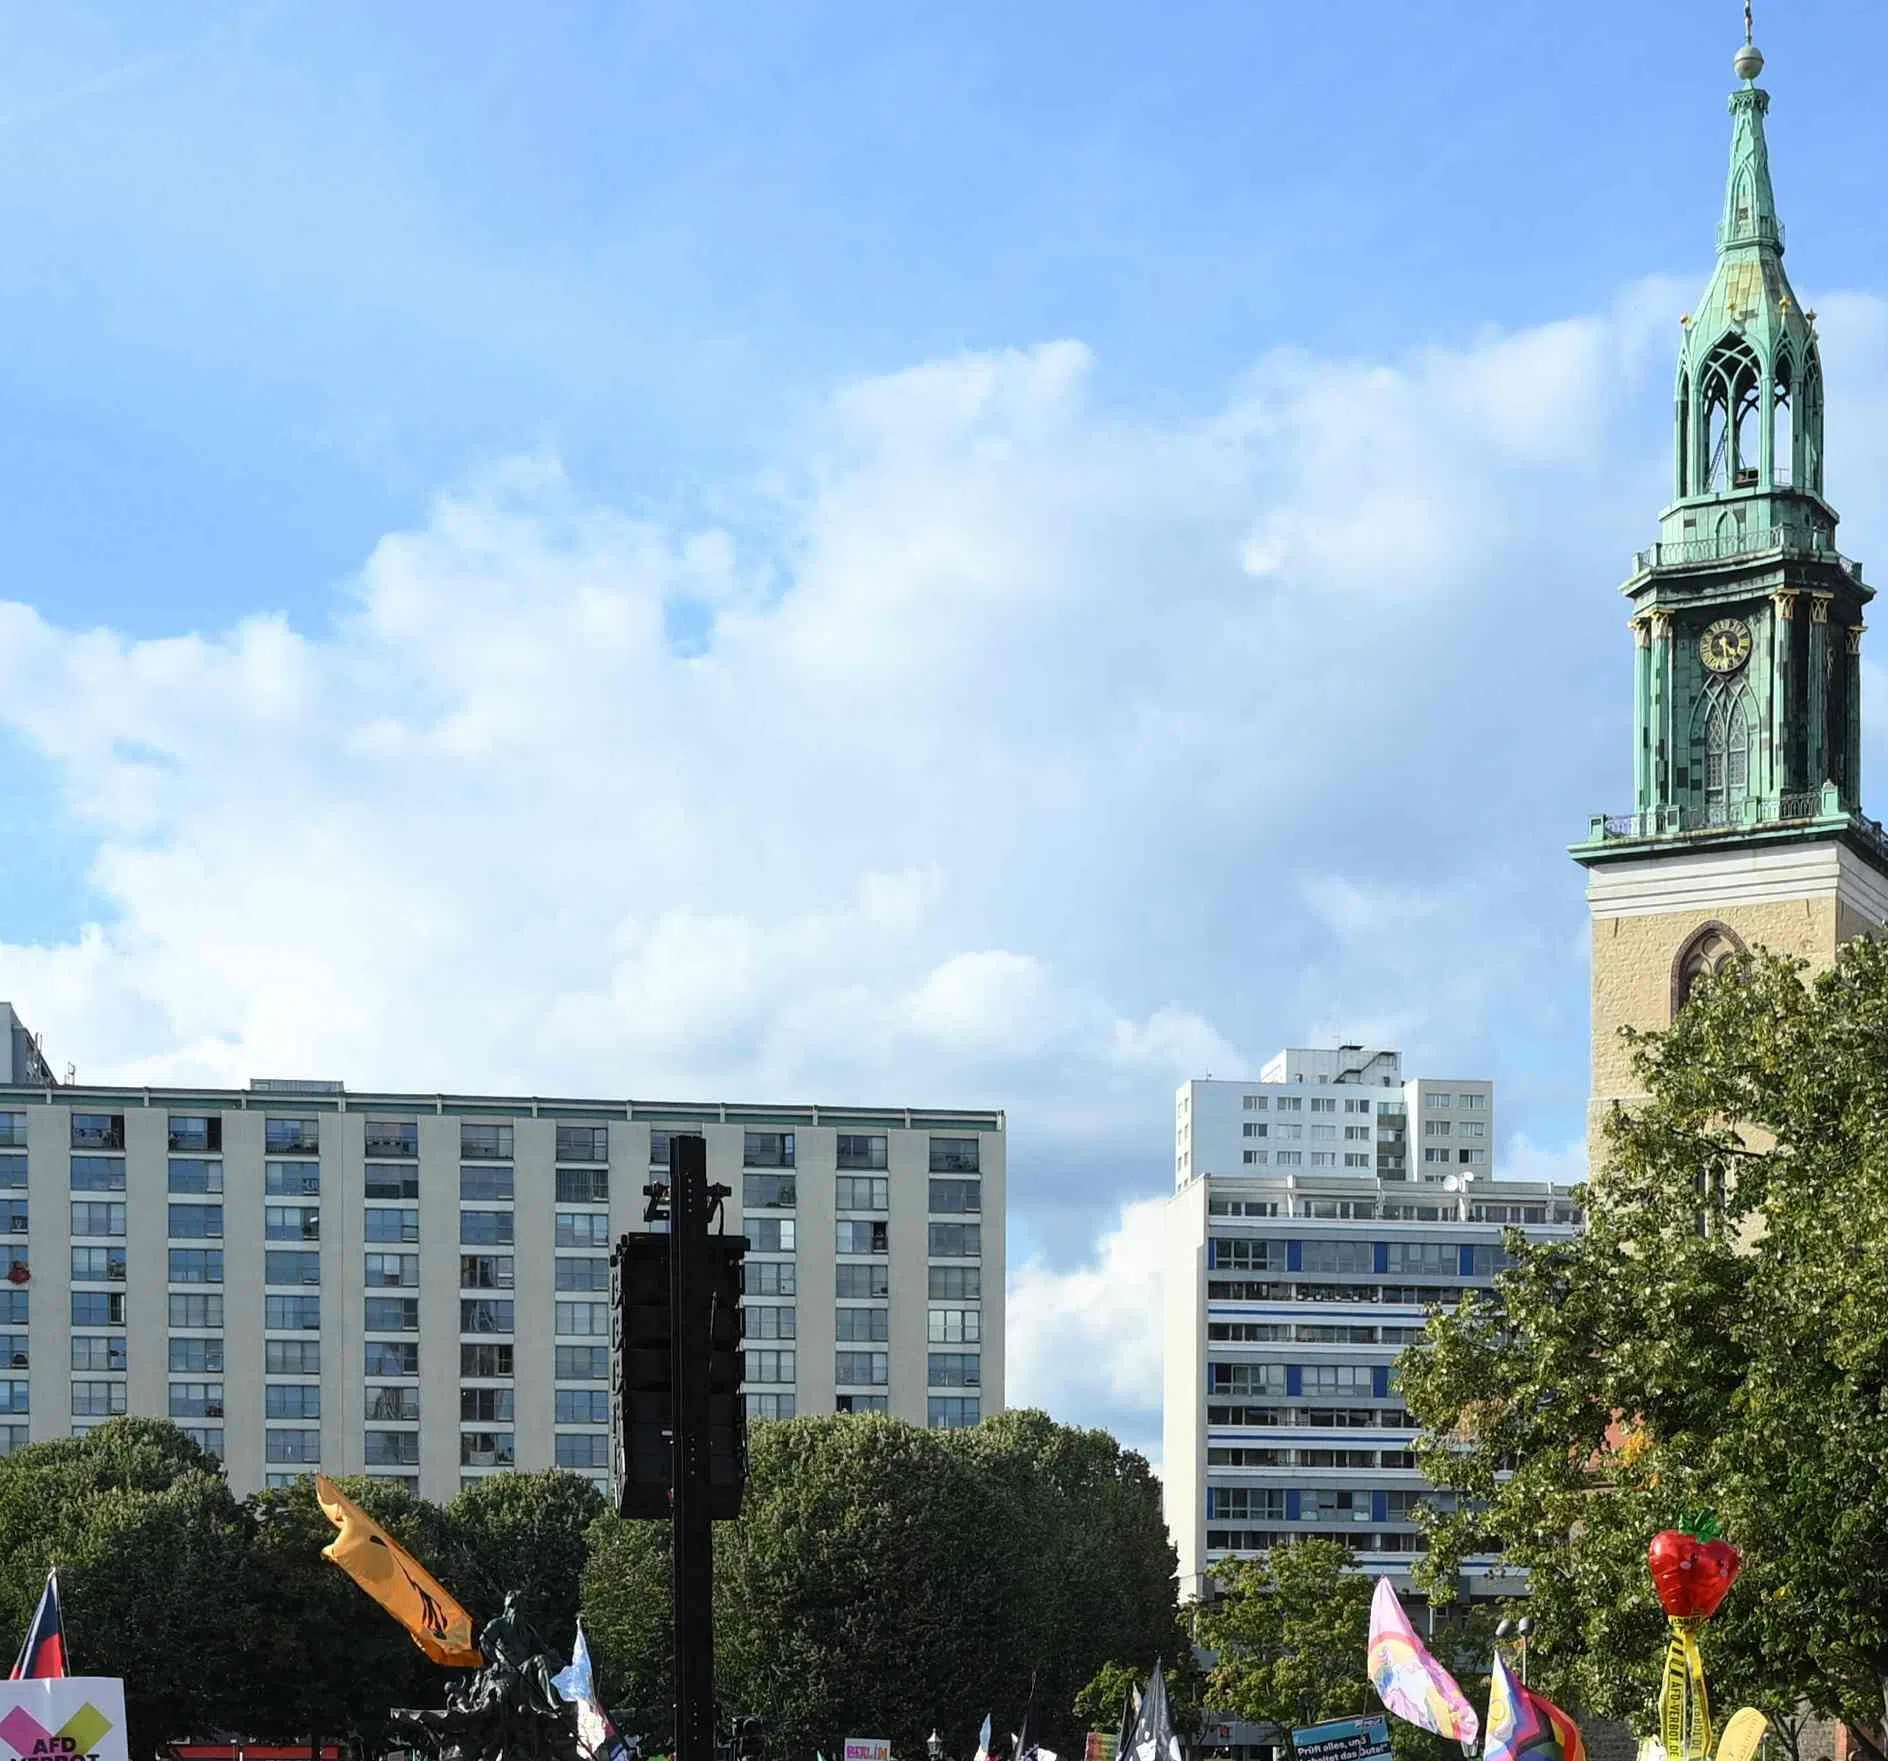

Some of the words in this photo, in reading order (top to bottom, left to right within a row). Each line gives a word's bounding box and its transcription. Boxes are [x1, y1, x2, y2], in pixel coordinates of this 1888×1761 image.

[31, 1736, 78, 1755] AFD
[1297, 1744, 1322, 1757] Prüft
[1348, 1736, 1367, 1746] und
[1340, 1751, 1358, 1761] das
